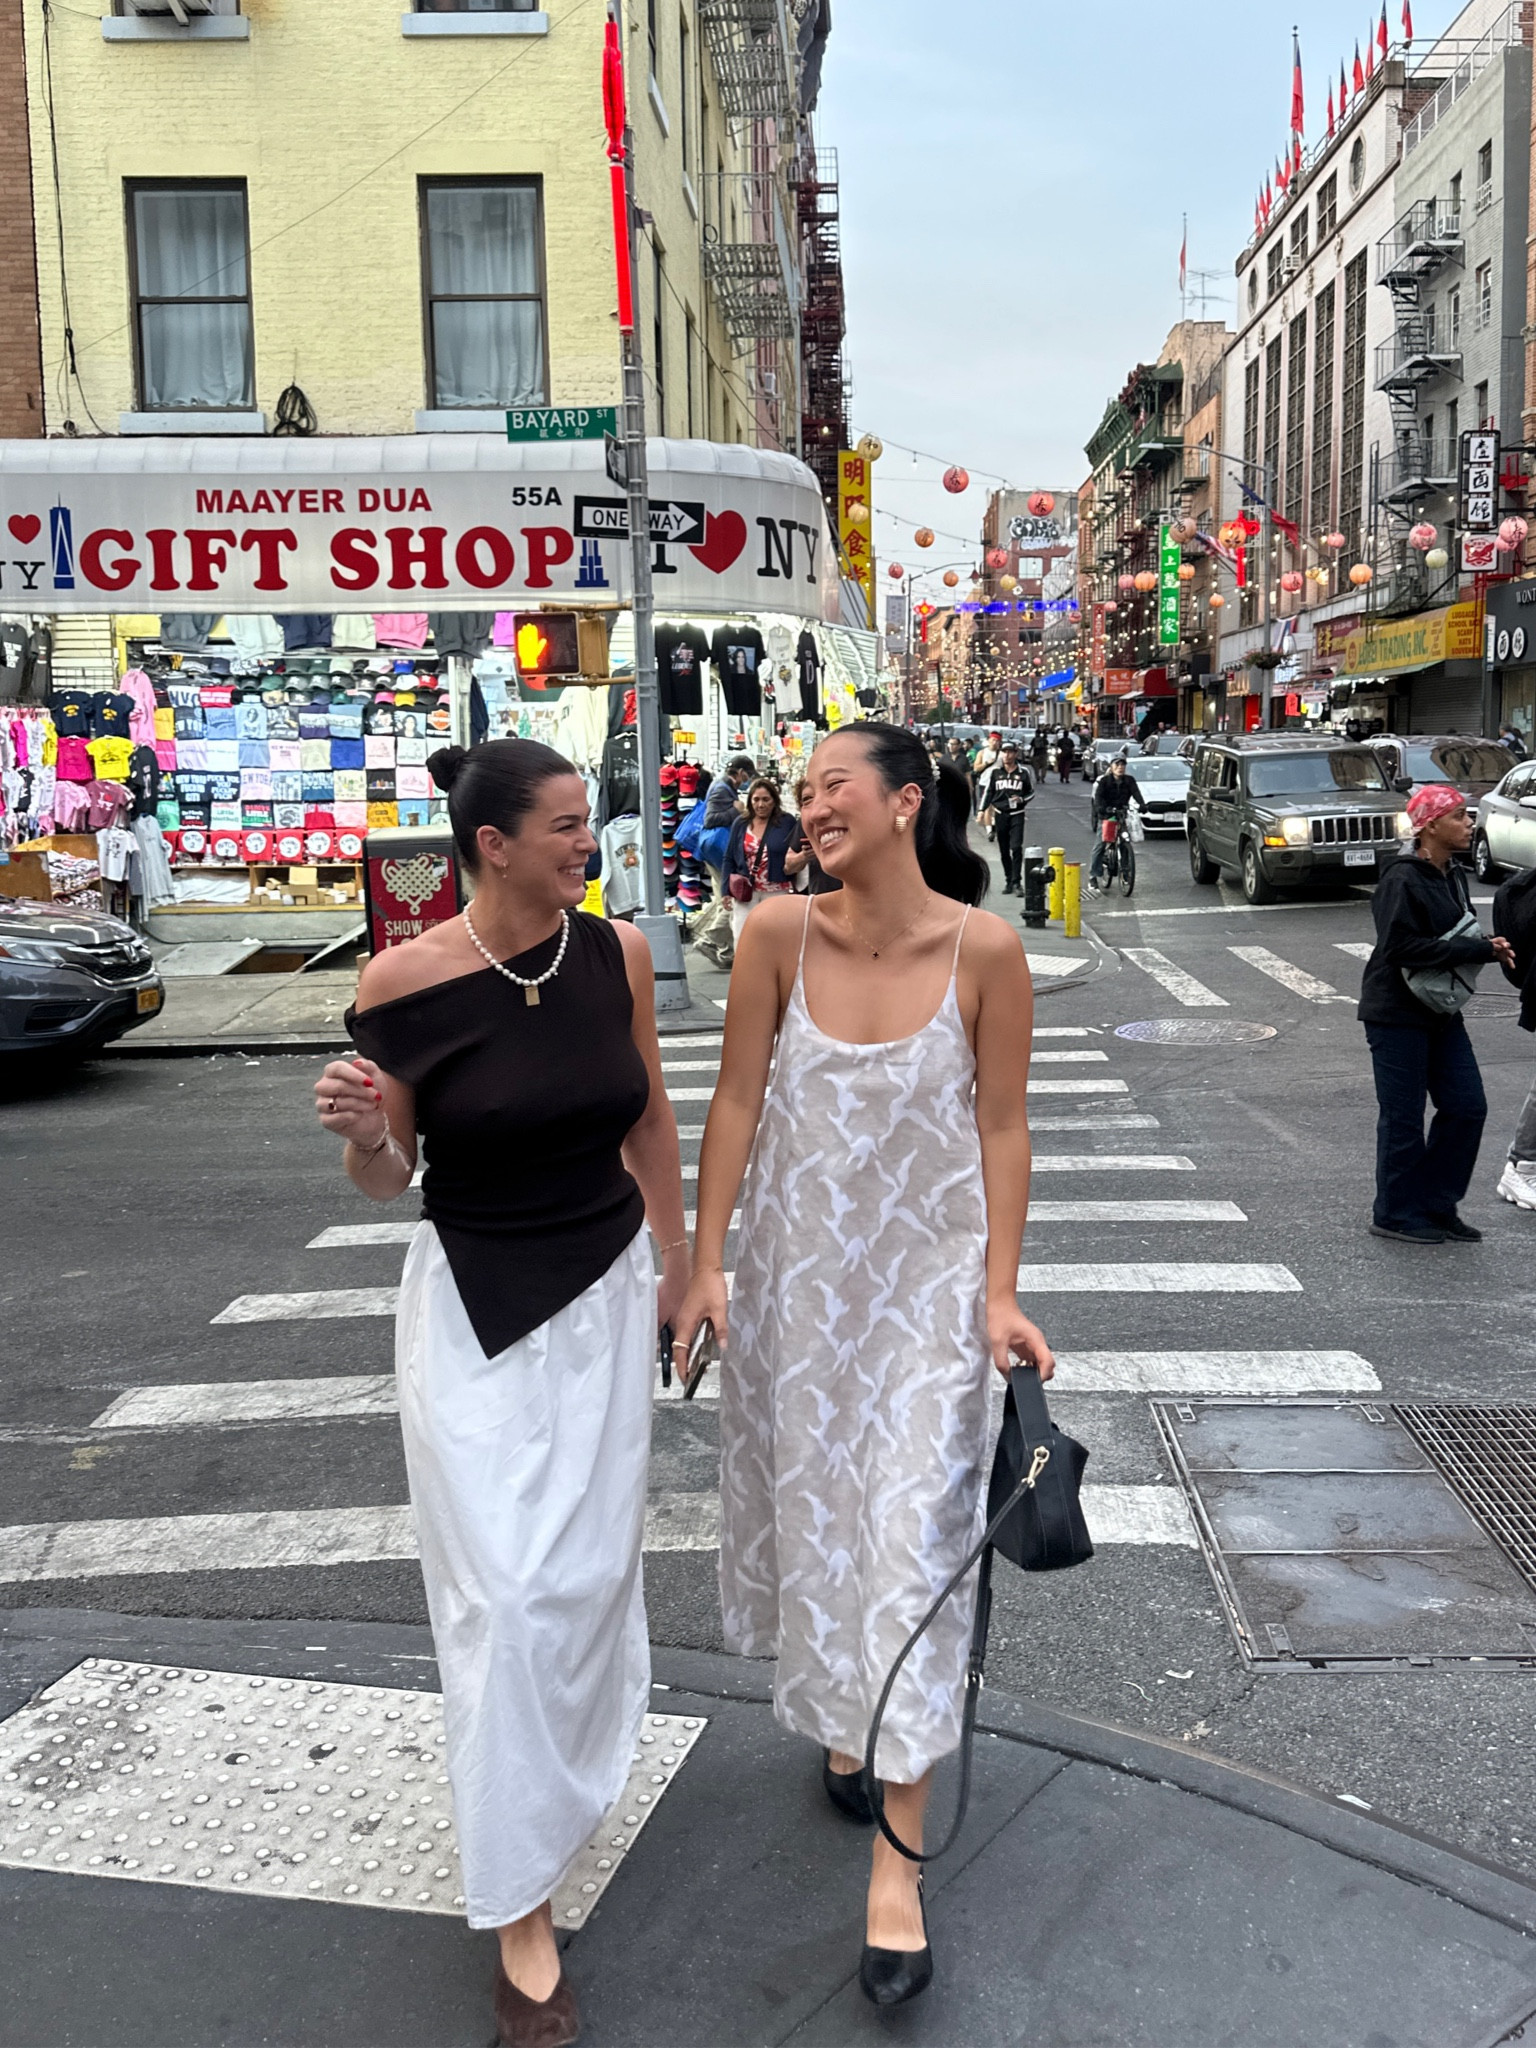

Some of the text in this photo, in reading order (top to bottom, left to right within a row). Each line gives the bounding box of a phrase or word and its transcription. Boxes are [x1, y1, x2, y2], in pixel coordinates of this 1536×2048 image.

[512, 408, 608, 429] BAYARD ST
[196, 487, 432, 513] MAAYER DUA
[511, 486, 562, 506] 55A
[592, 509, 686, 530] ONE WAY
[79, 526, 574, 592] GIFT SHOP
[756, 516, 819, 585] NY
[0, 560, 46, 590] Y
[1379, 631, 1412, 661] TRADING
[995, 779, 1023, 791] ITALIA
[385, 919, 423, 936] SHOW
